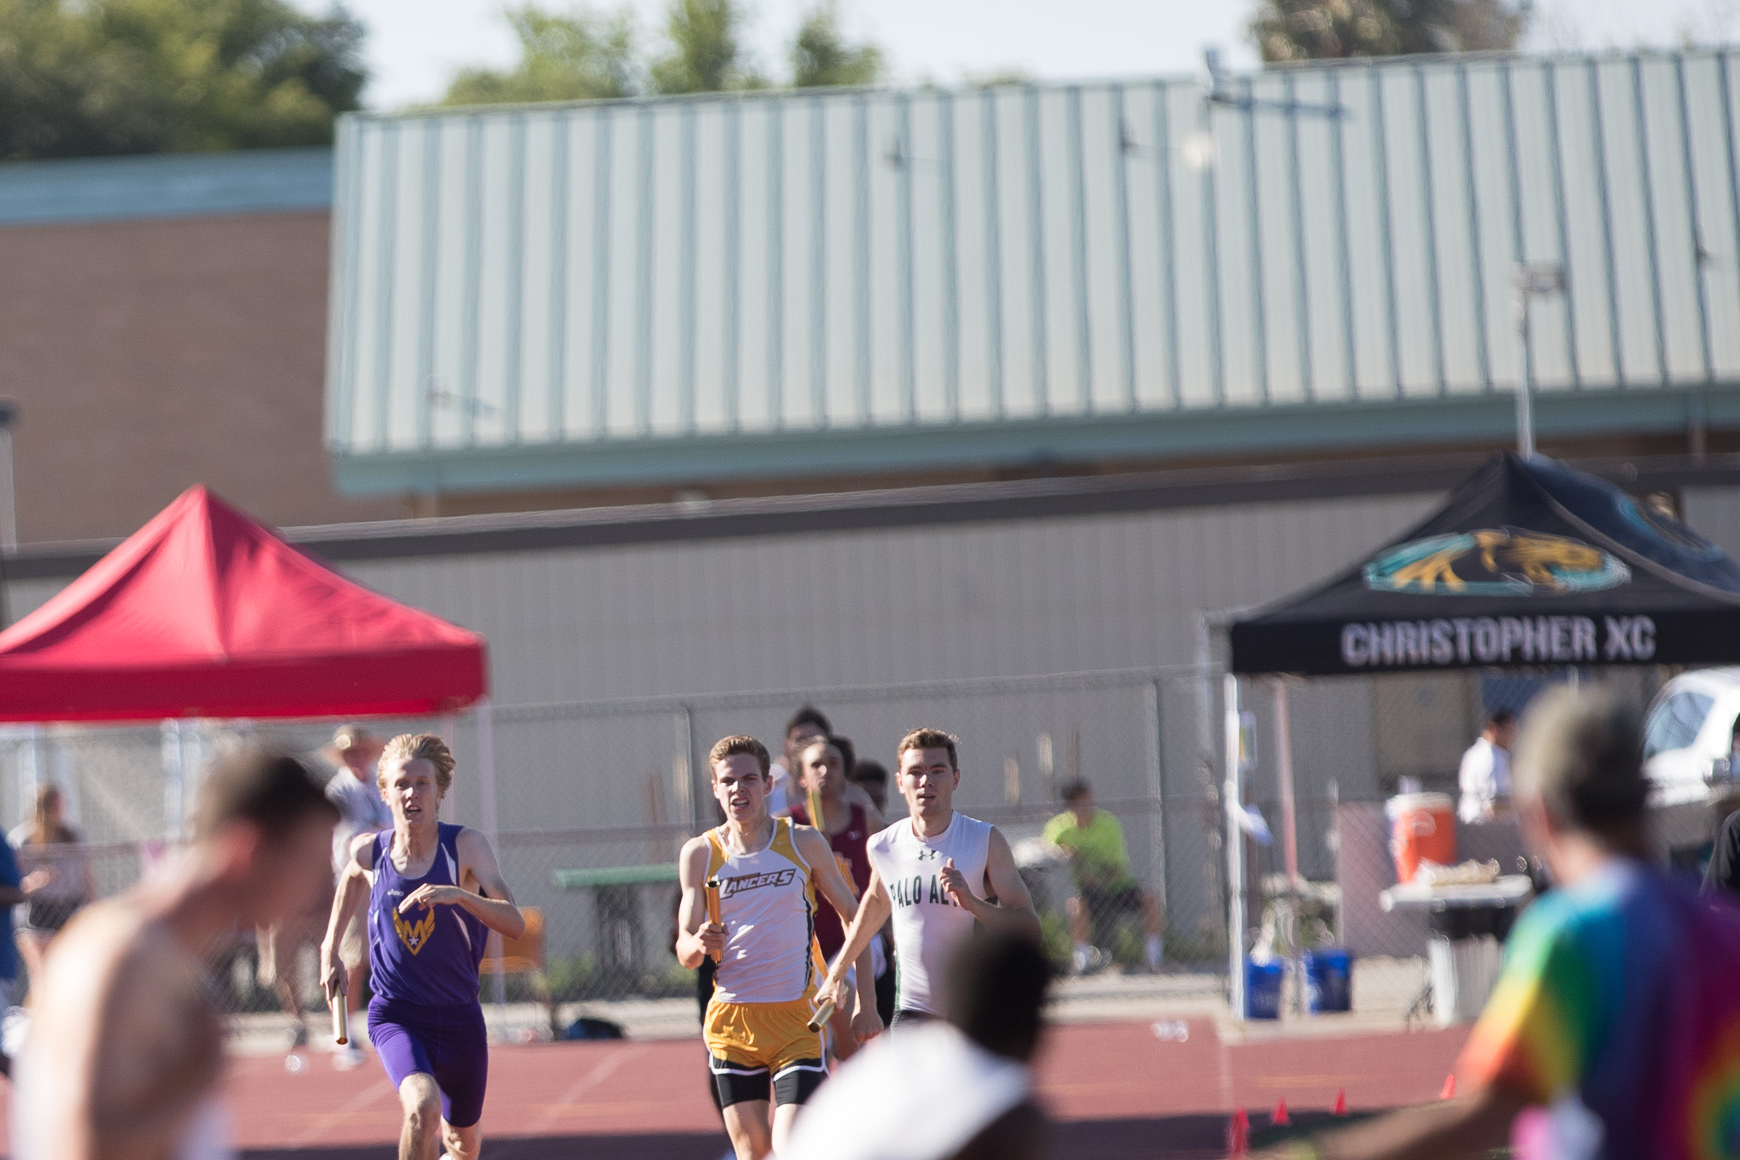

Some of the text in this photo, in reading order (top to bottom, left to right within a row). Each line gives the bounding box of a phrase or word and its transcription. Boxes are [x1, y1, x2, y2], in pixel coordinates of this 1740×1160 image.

[1341, 614, 1657, 667] CHRISTOPHER XC
[719, 869, 796, 900] LANCERS
[890, 875, 922, 909] PALO
[929, 874, 960, 908] AL
